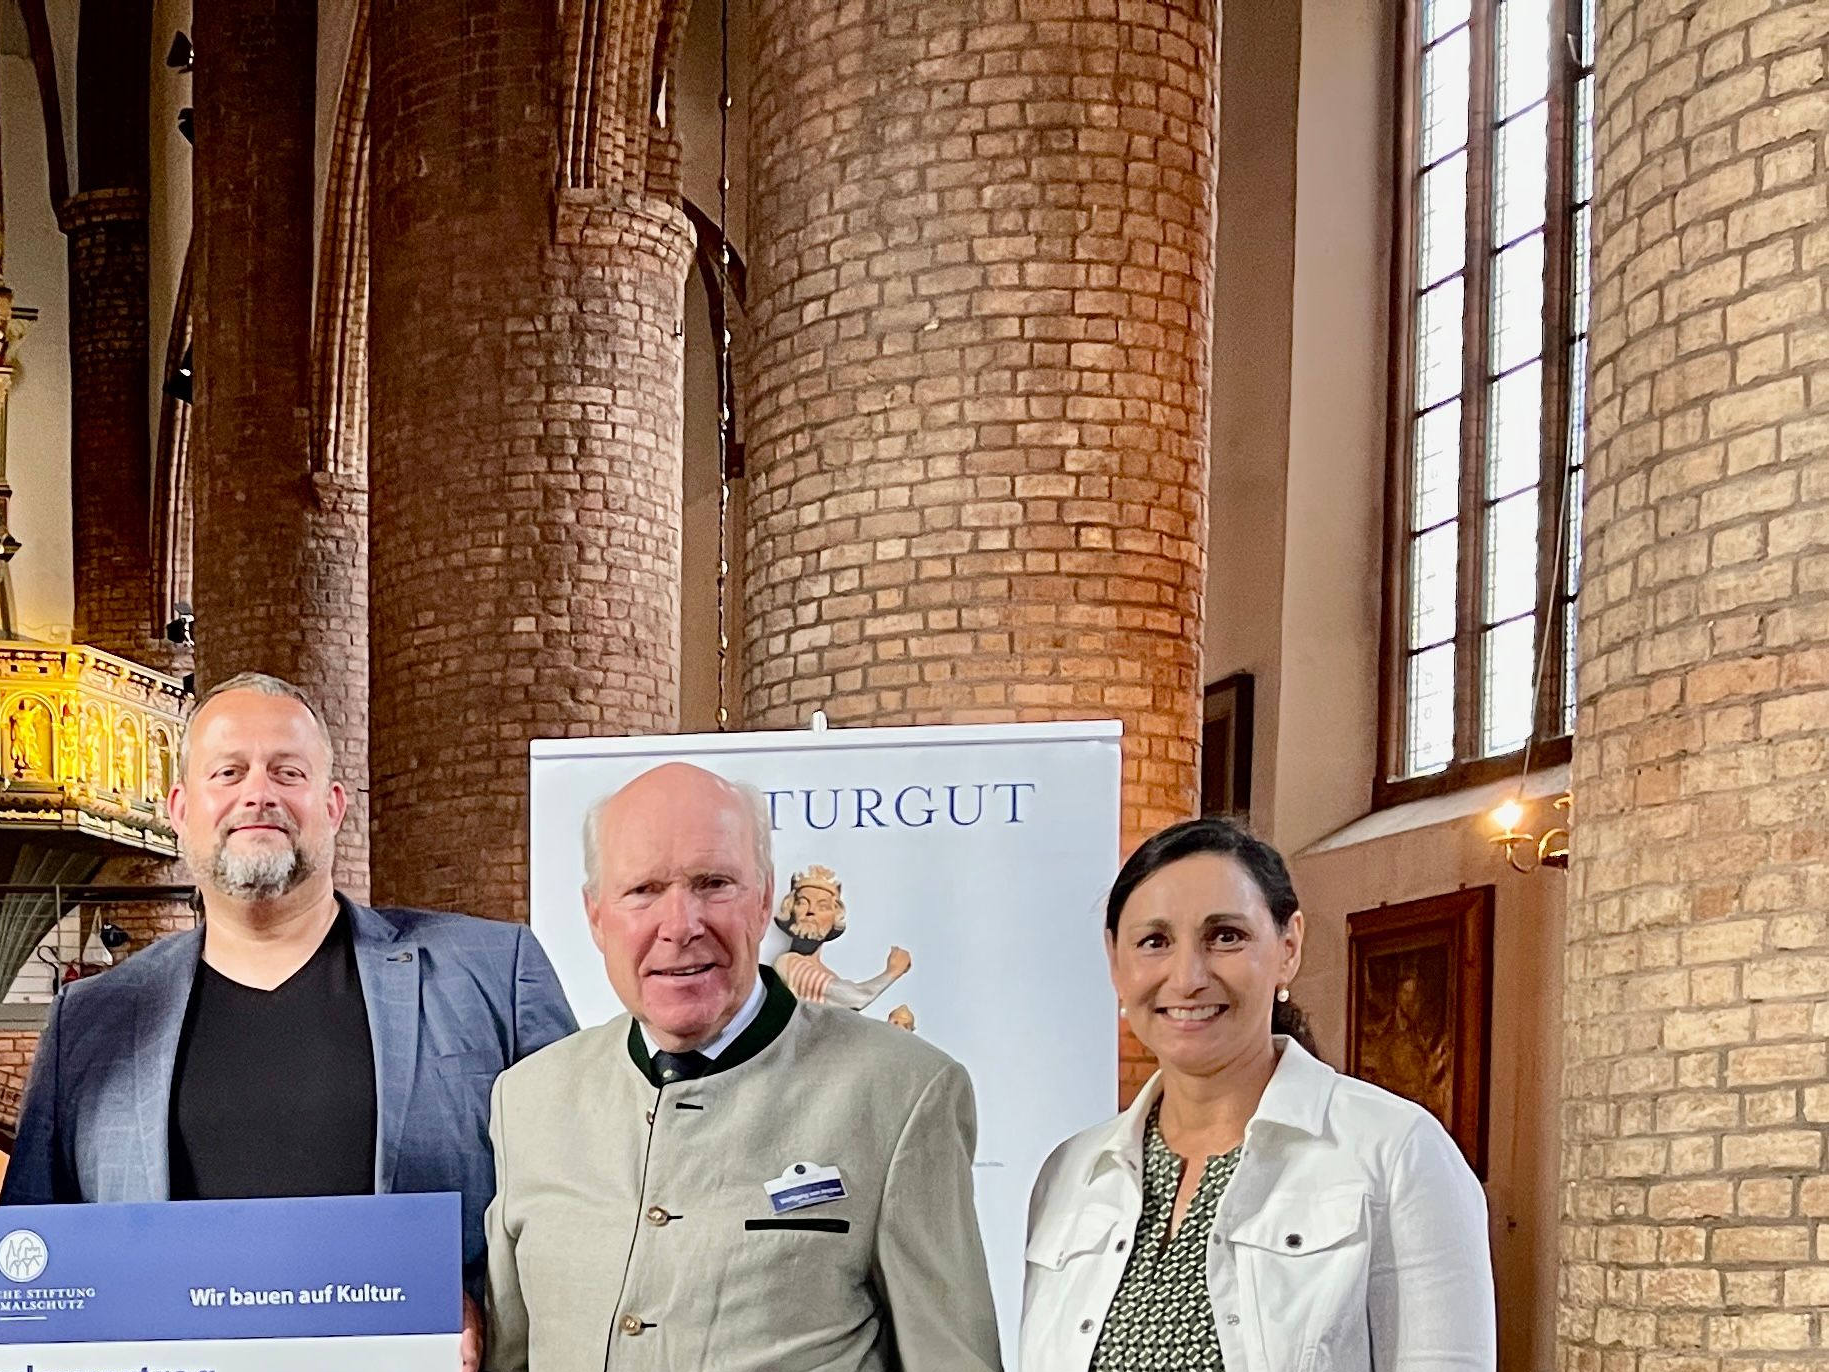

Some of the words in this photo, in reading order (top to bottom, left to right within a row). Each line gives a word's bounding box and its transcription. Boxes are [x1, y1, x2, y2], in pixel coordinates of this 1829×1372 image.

[762, 783, 1036, 831] TURGUT
[26, 1287, 96, 1299] STIFTUNG
[189, 1288, 226, 1306] Wir
[229, 1286, 294, 1306] bauen
[298, 1284, 333, 1304] auf
[336, 1283, 406, 1303] Kultur.
